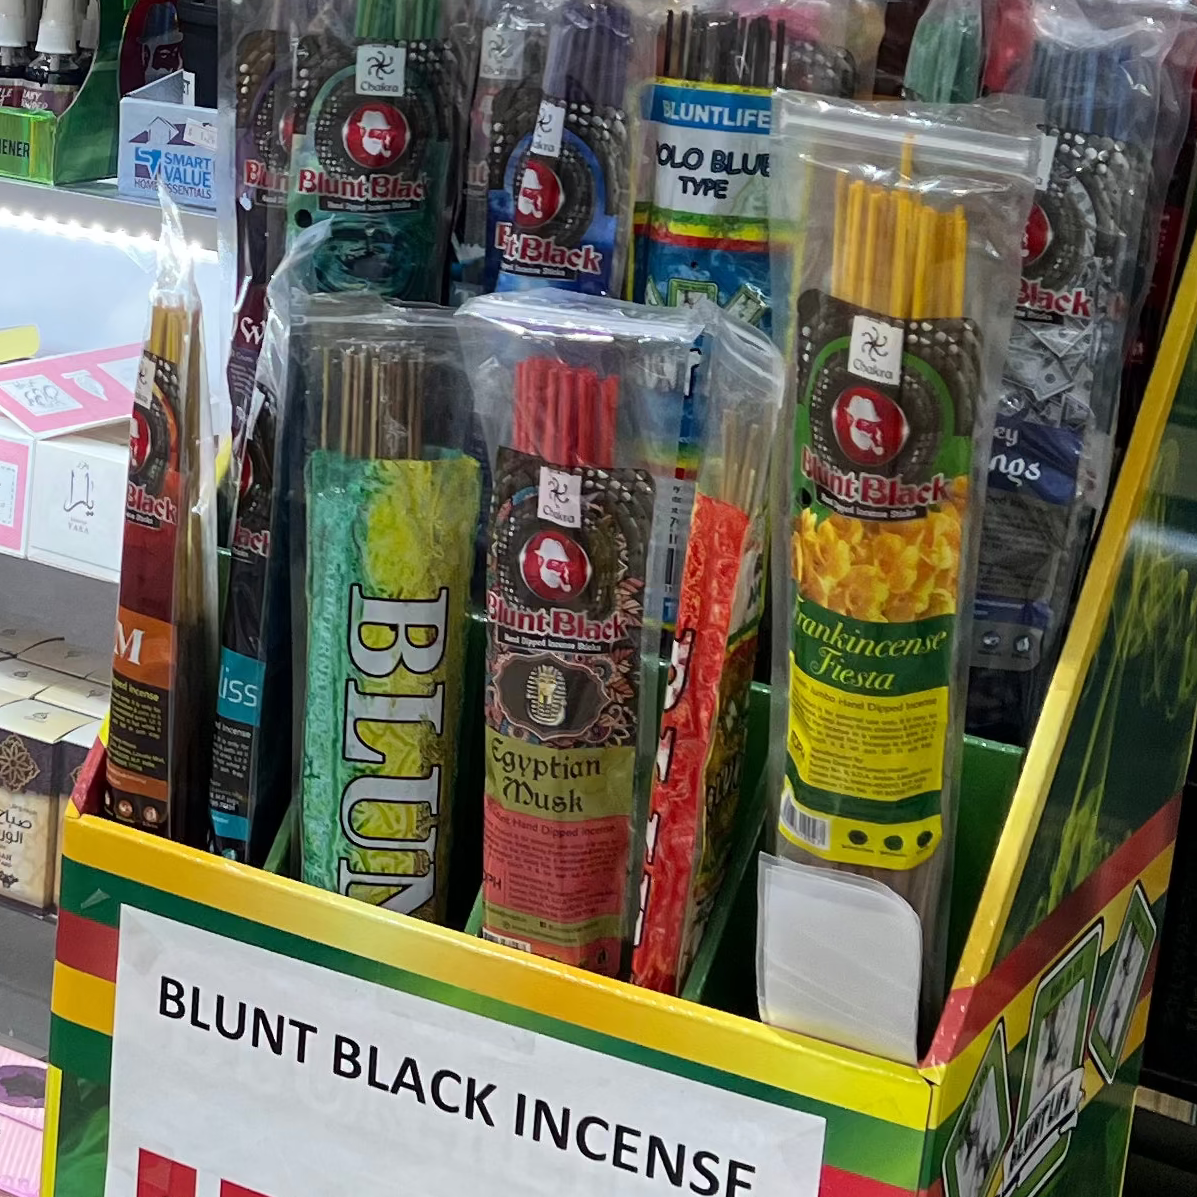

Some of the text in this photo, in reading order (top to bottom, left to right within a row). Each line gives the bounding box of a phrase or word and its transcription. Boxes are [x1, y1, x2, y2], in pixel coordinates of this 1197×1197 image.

[360, 80, 400, 93] Chakra
[662, 99, 771, 129] BLUNTLIFE
[164, 152, 212, 170] SMART
[533, 141, 555, 153] akra
[656, 140, 770, 178] OLO BLUE
[163, 182, 212, 200] SSENTIALS
[164, 165, 212, 189] VALUE
[244, 160, 289, 192] Blun
[299, 169, 428, 200] Blunt Blac
[678, 175, 730, 200] TYPE
[519, 234, 602, 274] Black
[1016, 279, 1092, 318] Black
[853, 359, 894, 380] Chakra
[860, 475, 951, 506] Black
[487, 590, 627, 641] Blunt Black
[796, 608, 948, 659] rankincense
[809, 646, 896, 691] Fiesta
[218, 664, 260, 708] liss
[867, 701, 904, 714] Dipped
[491, 738, 602, 782] Egyptian
[502, 776, 584, 814] Musk
[541, 824, 579, 838] Dipped
[158, 975, 757, 1197] BLUNT BLACK INCENSE
